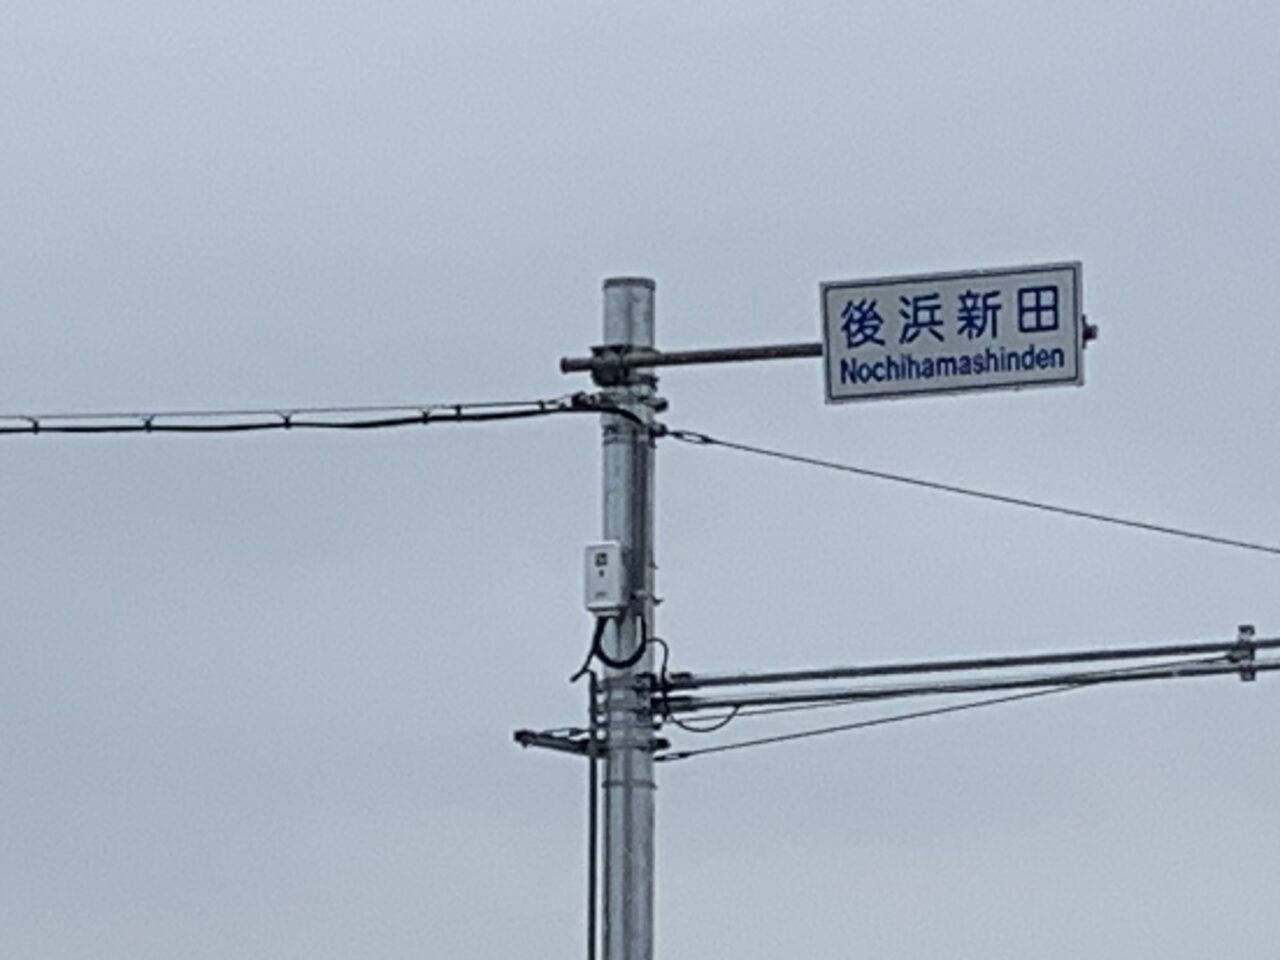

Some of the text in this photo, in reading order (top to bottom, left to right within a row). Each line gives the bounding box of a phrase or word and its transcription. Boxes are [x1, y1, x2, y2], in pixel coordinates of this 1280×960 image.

[841, 286, 1059, 349] 後浜新田
[840, 344, 1065, 384] Nochihamashinden
